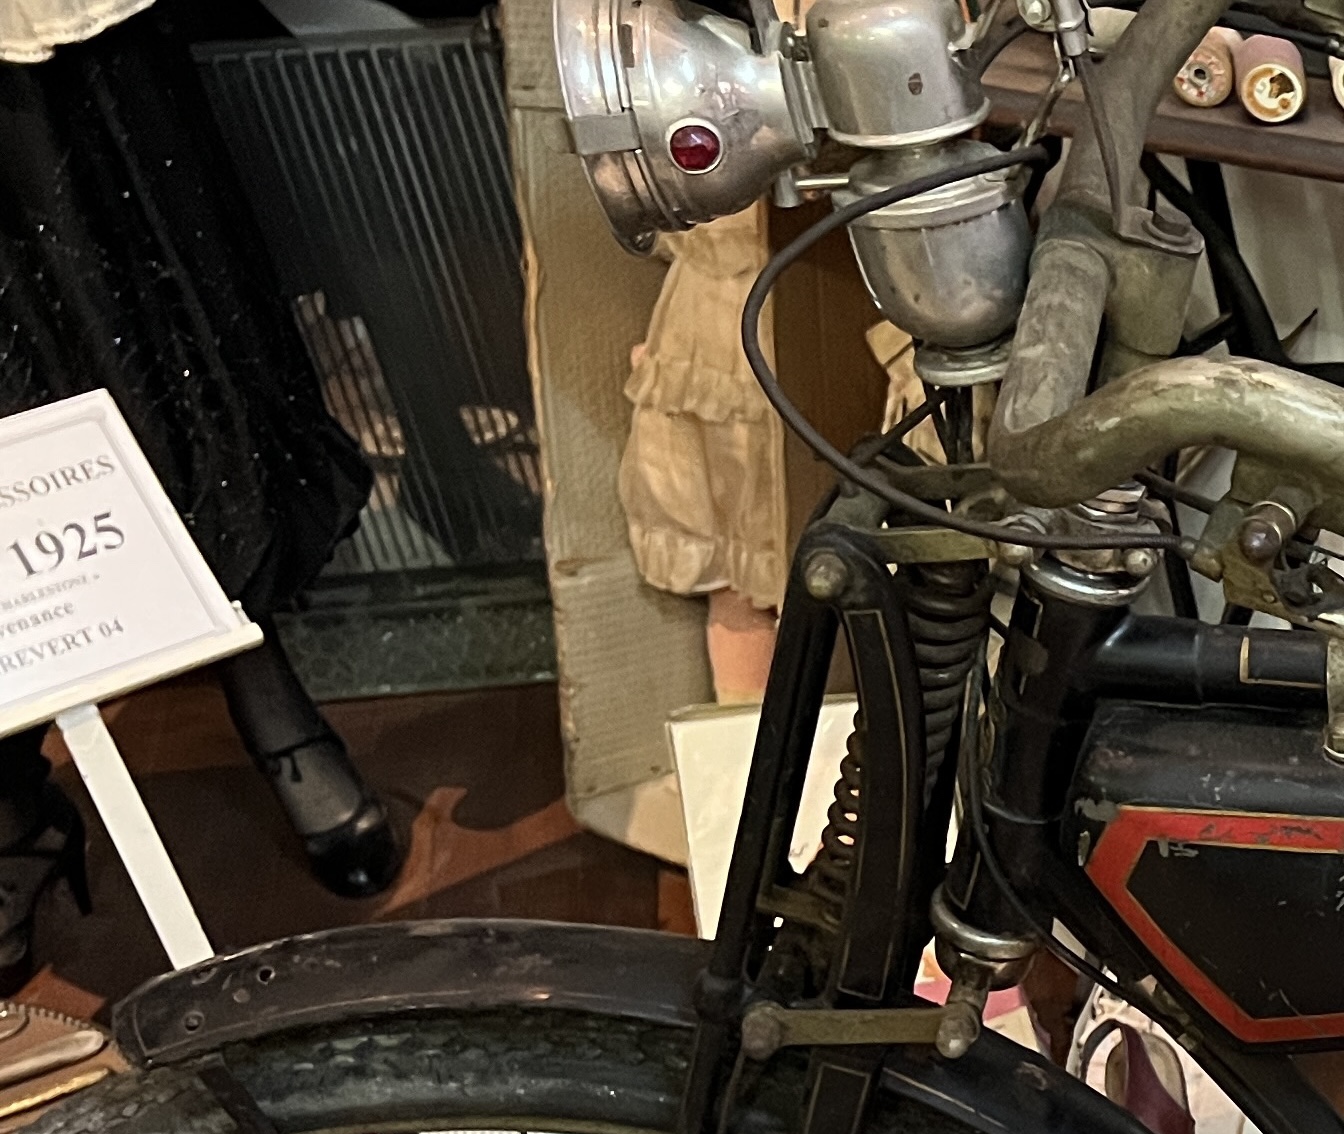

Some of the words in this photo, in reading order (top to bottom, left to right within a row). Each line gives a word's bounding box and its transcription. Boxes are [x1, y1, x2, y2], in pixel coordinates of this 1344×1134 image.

[0, 454, 115, 508] SSOIRES
[7, 509, 125, 580] 1925
[0, 626, 94, 676] REVERT
[98, 618, 125, 639] 04
